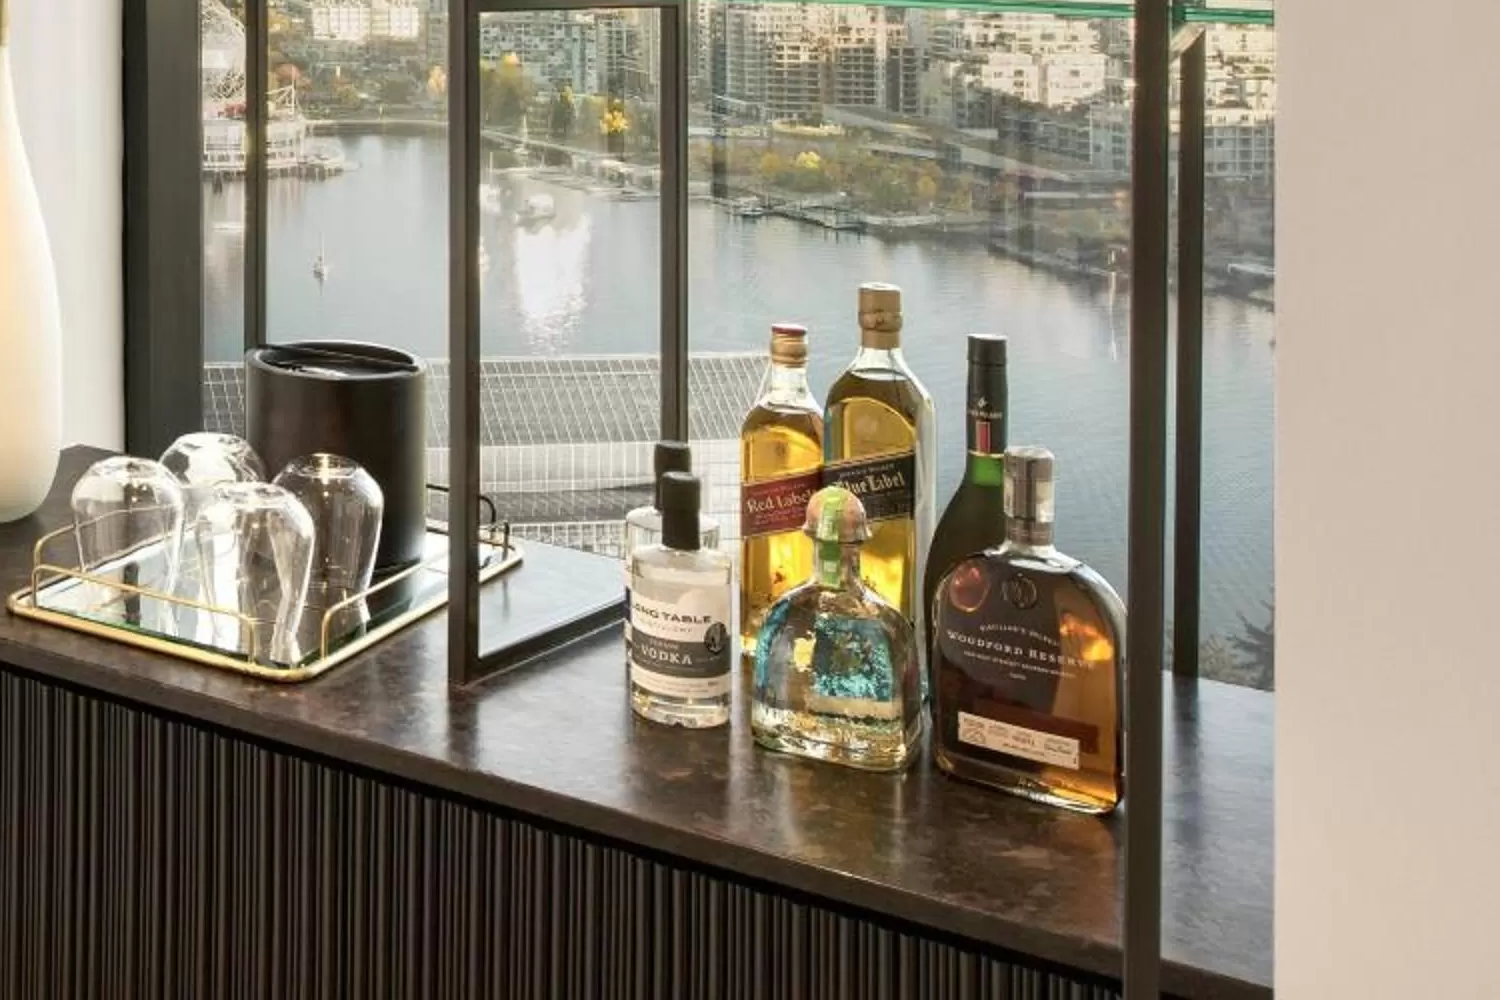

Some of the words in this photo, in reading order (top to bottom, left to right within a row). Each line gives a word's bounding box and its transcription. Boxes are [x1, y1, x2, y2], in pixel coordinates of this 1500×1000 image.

[865, 470, 906, 491] Label
[746, 496, 775, 512] Red
[661, 612, 712, 624] TABLE
[947, 628, 1023, 656] WOODFORD
[641, 644, 693, 666] VODKA
